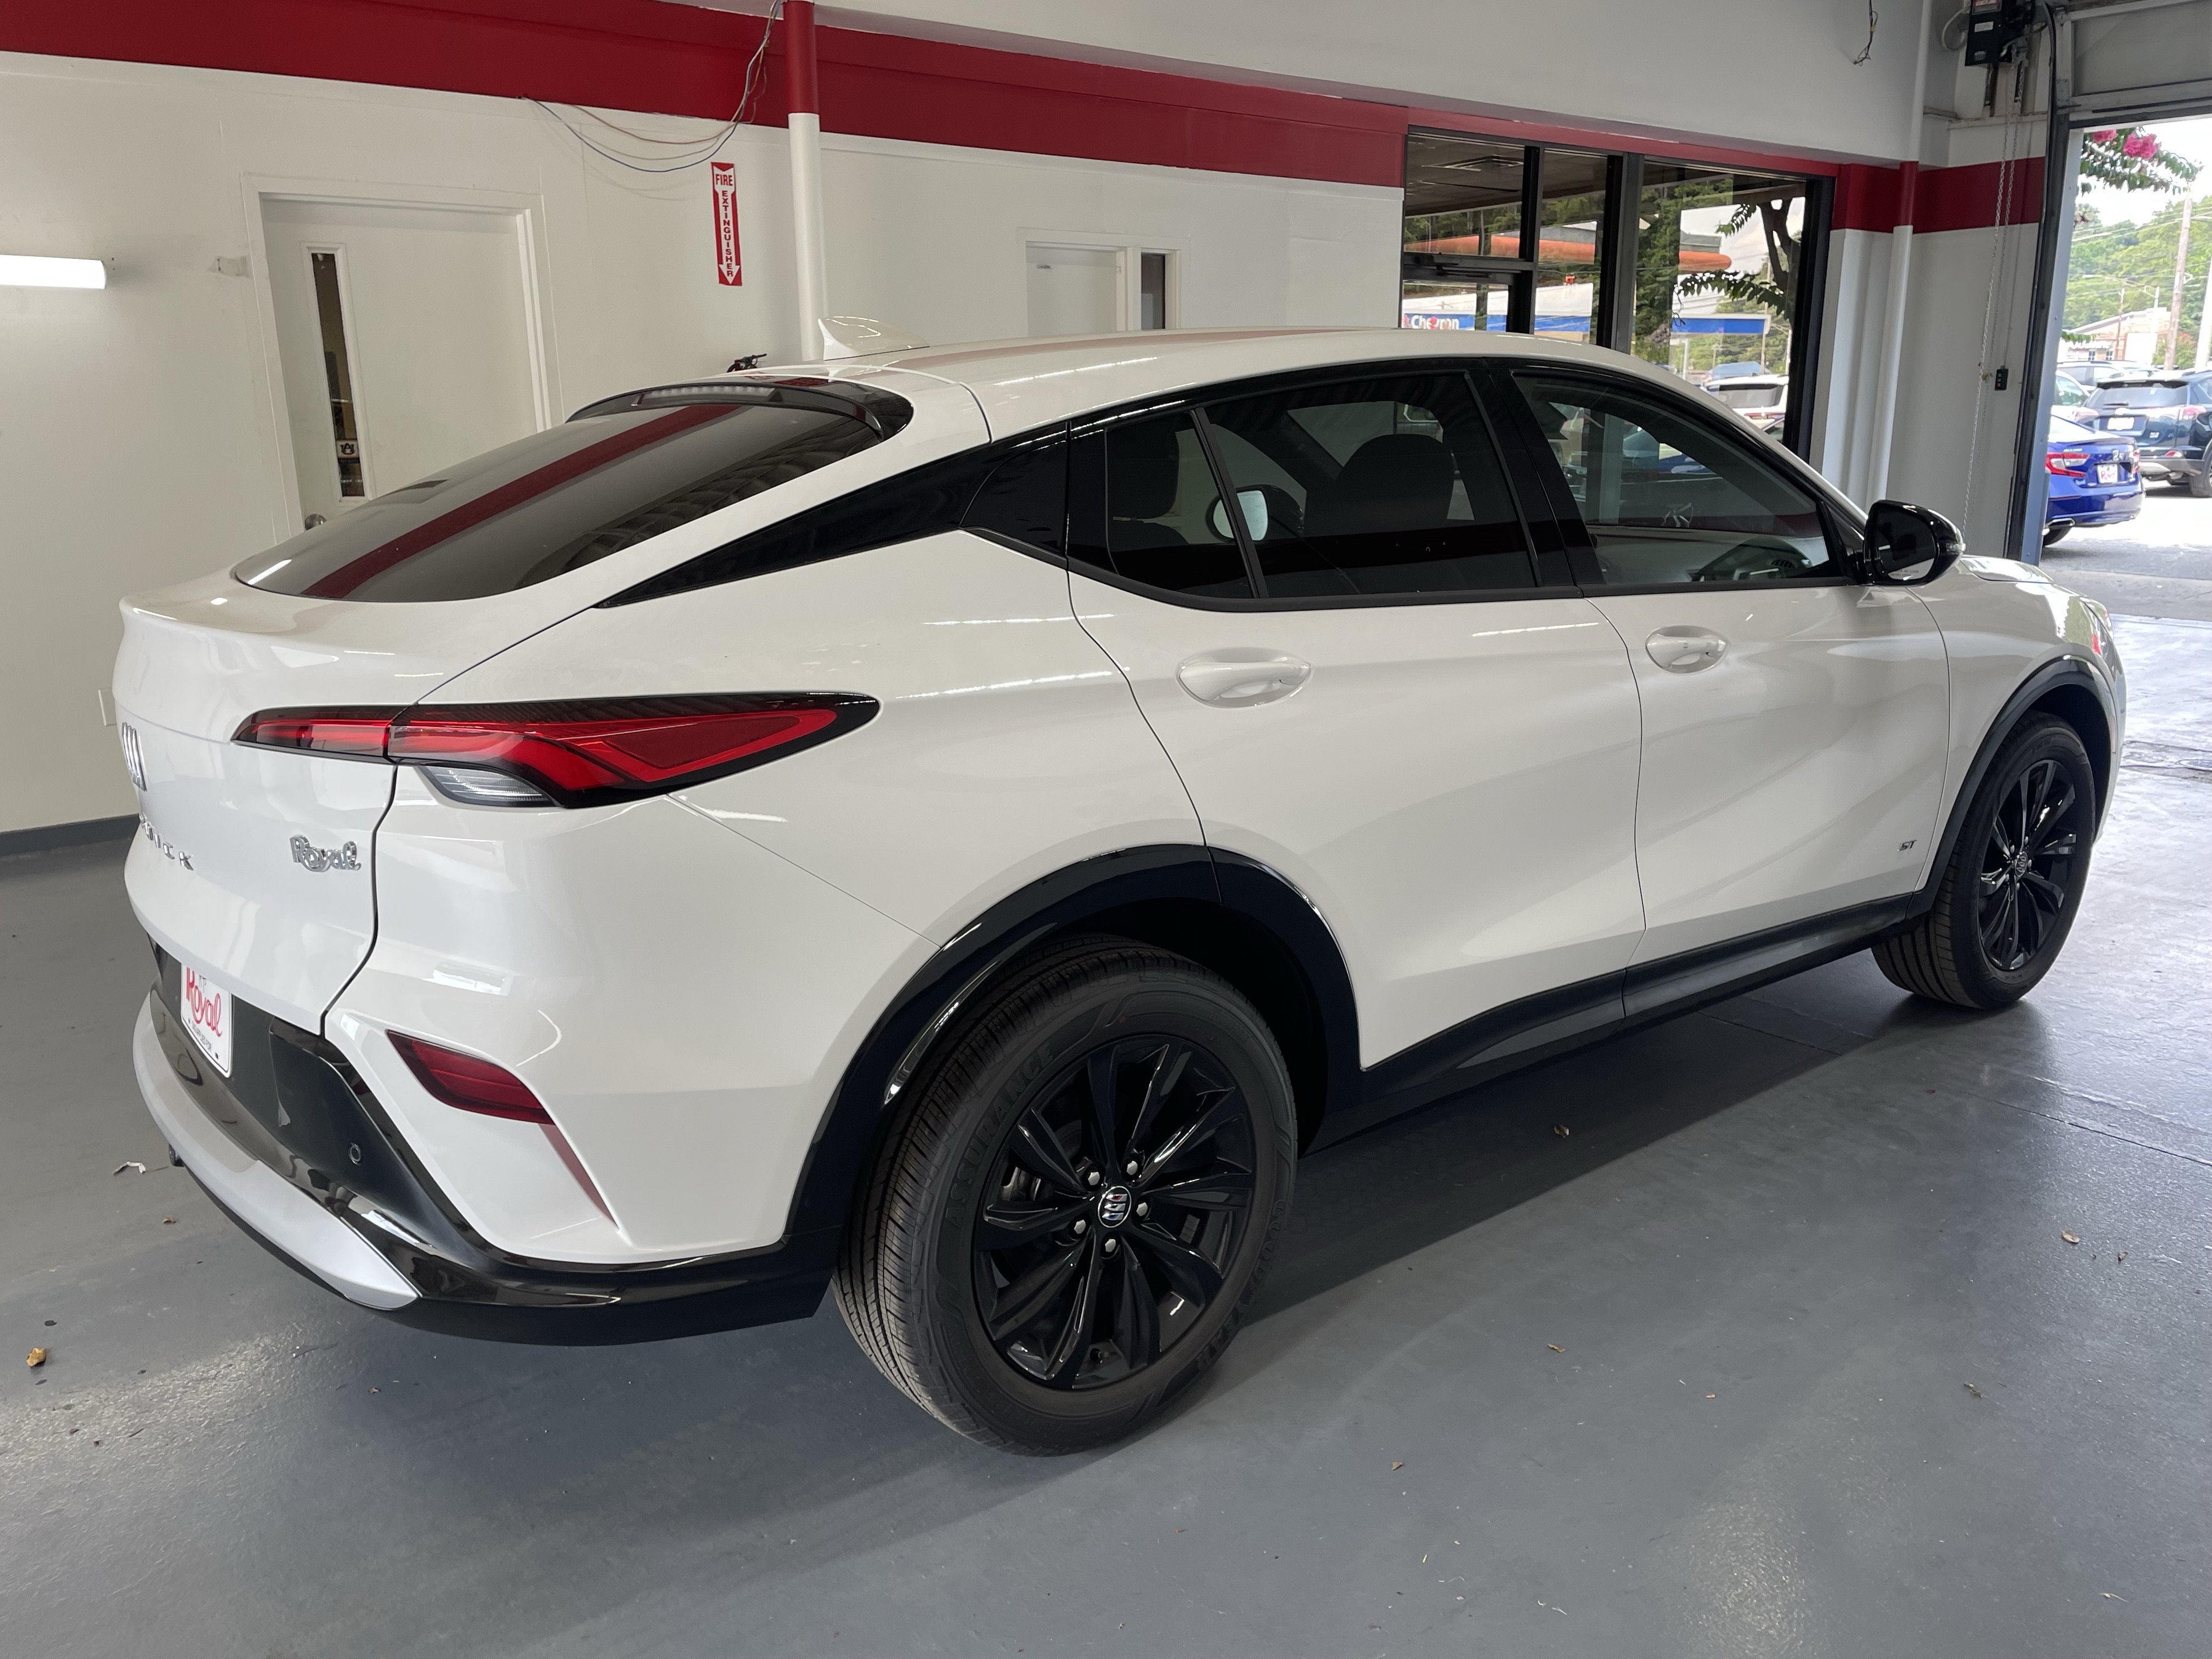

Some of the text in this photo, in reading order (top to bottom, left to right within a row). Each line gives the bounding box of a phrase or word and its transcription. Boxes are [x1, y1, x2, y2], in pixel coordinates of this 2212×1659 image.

[716, 174, 733, 186] FIRE
[722, 190, 733, 277] EXTINGUISHER
[289, 834, 362, 872] Royal
[1898, 839, 1917, 852] ST
[186, 967, 222, 1037] Royal
[945, 1043, 1054, 1228] ASSURANCE
